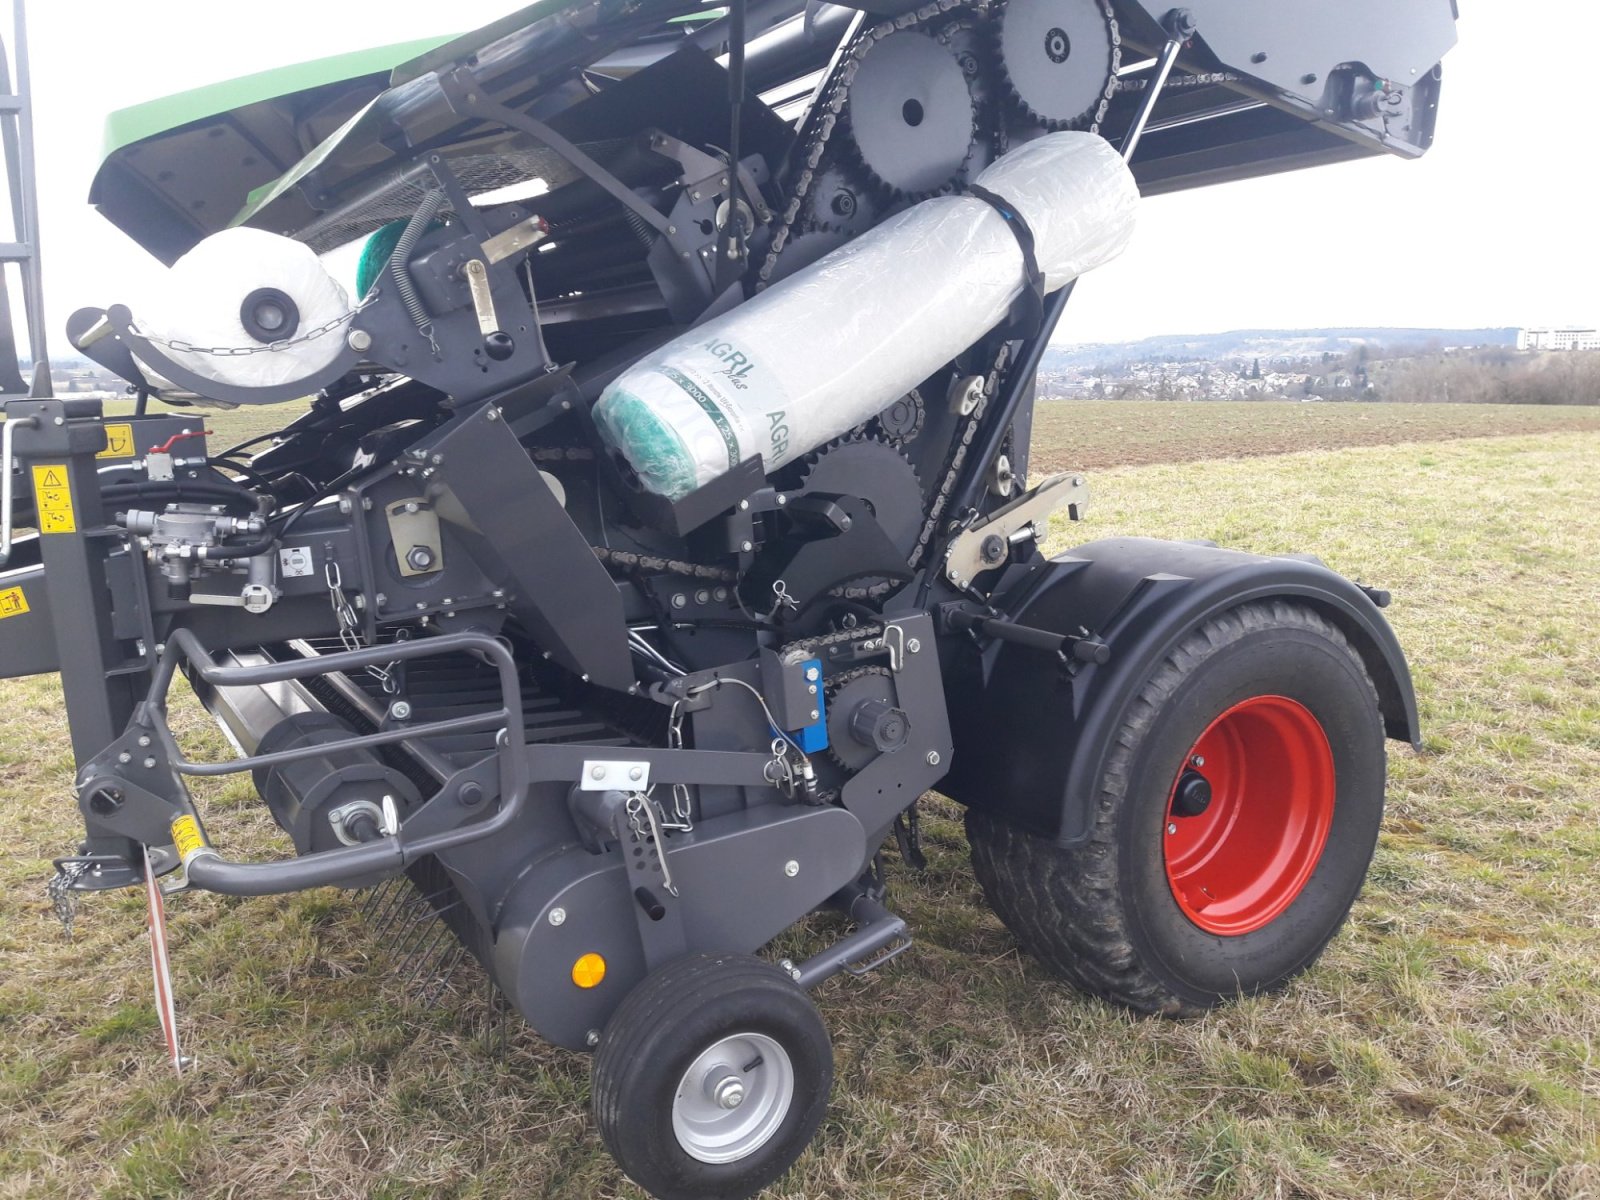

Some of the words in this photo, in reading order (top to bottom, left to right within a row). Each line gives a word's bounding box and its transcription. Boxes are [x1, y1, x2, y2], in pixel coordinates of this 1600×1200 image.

[704, 338, 754, 376] AGRI
[685, 383, 707, 403] 3000
[712, 369, 748, 390] plus
[766, 410, 789, 464] AGRI
